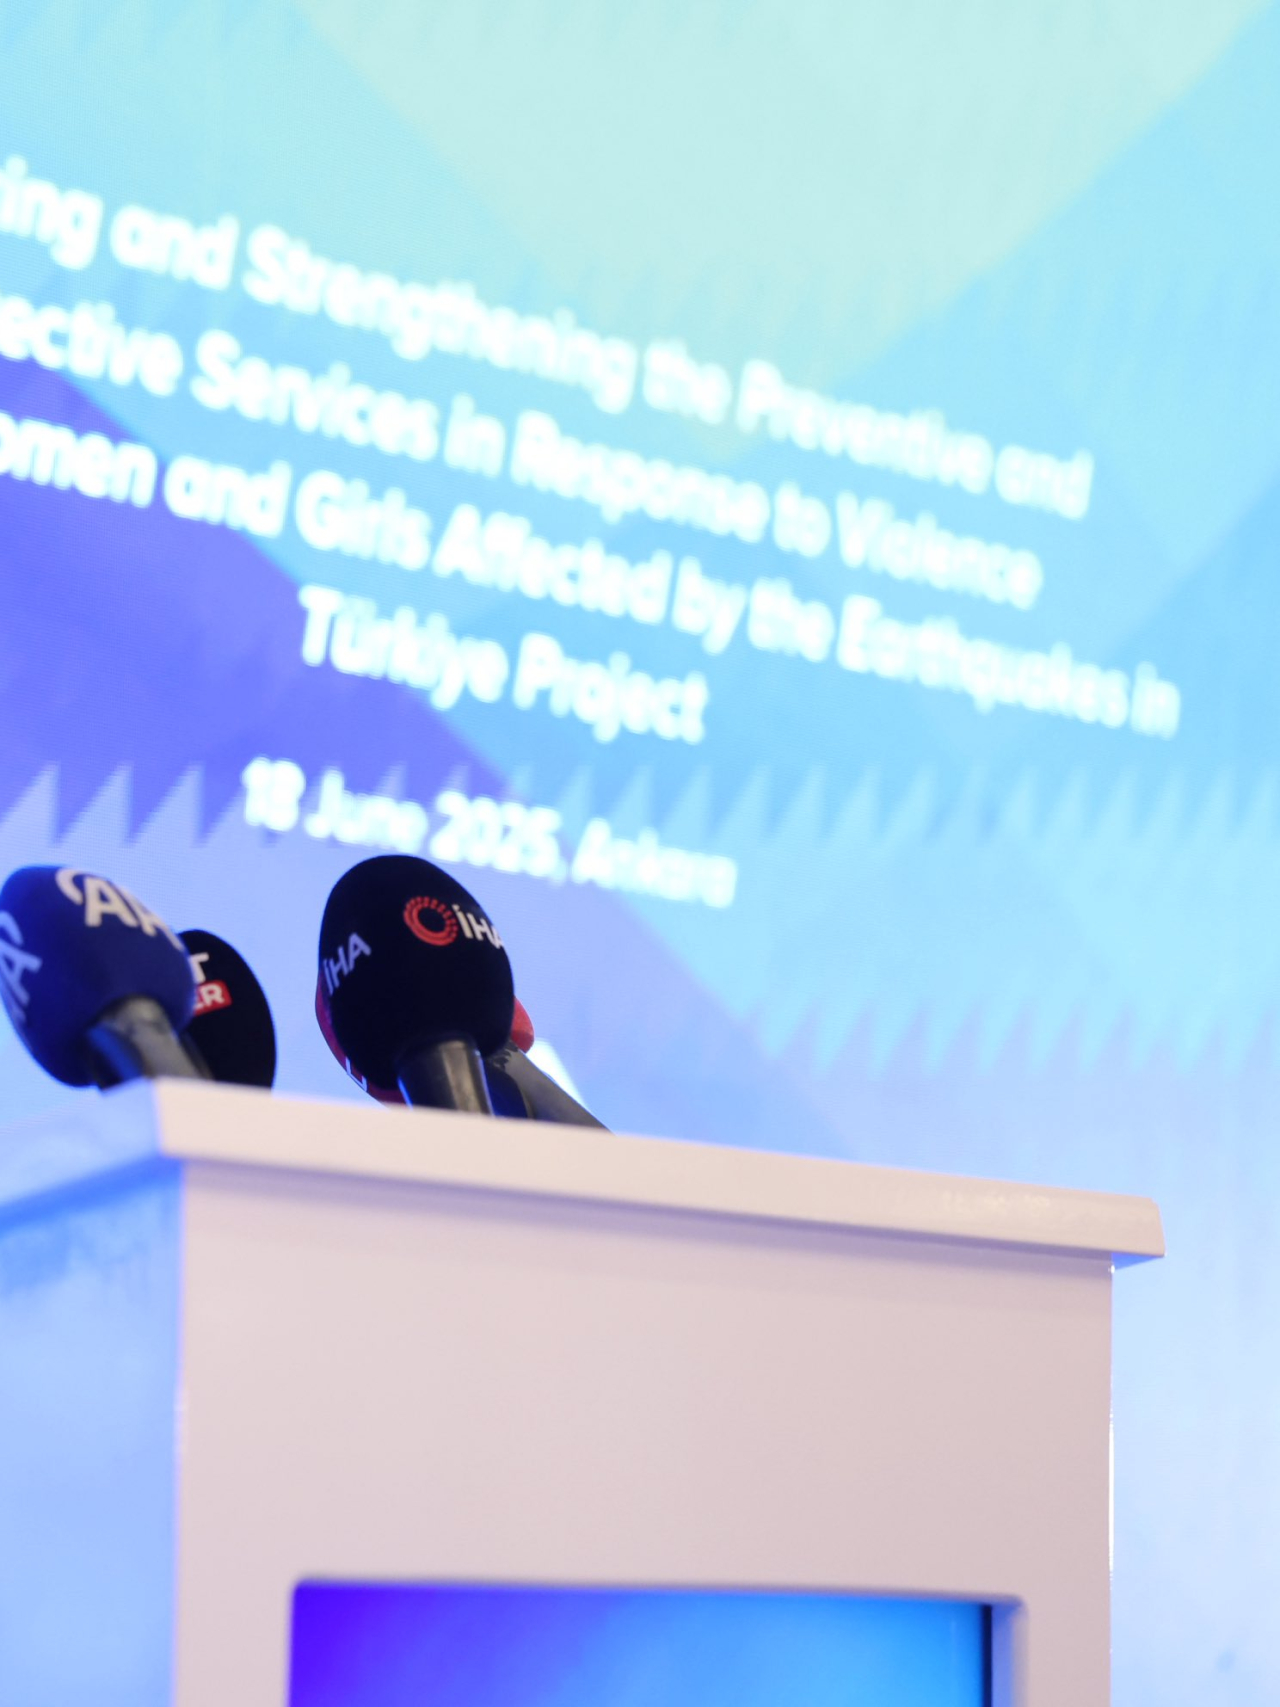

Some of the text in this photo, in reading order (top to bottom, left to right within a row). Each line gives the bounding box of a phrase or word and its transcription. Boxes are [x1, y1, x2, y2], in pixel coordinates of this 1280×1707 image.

[110, 206, 239, 290] and
[244, 225, 637, 413] Strengthening
[644, 345, 731, 423] the
[738, 361, 994, 493] Preventive
[996, 447, 1093, 519] and
[192, 330, 438, 461] Services
[444, 395, 506, 476] in
[511, 410, 770, 543] Response
[775, 485, 831, 557] to
[837, 493, 1043, 609] Violence
[164, 456, 292, 537] and
[295, 471, 431, 570] Girls
[433, 504, 673, 624] Affected
[673, 558, 747, 655] by
[748, 579, 835, 662] the
[838, 595, 1129, 728] Earthquakes
[1131, 664, 1180, 739] in
[300, 585, 709, 743] Türkiye Project
[305, 769, 429, 854] June
[571, 819, 738, 907] Ankara
